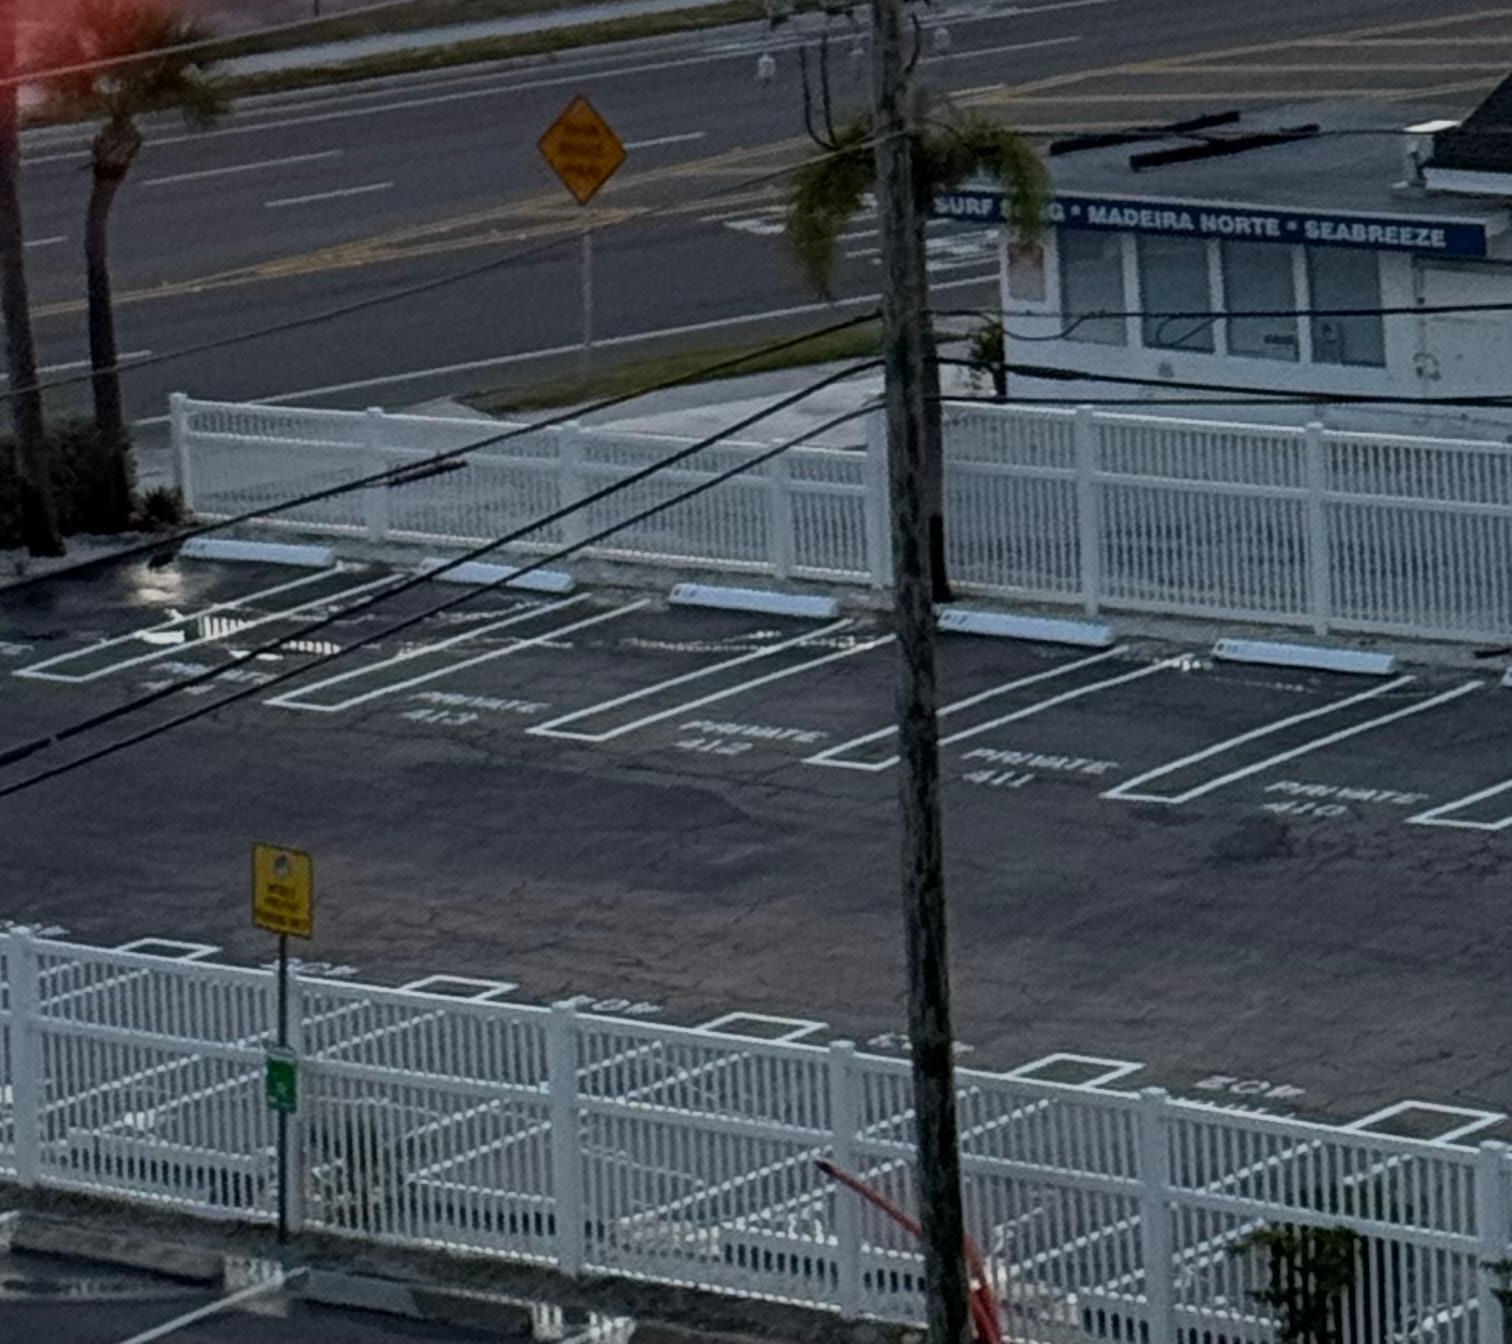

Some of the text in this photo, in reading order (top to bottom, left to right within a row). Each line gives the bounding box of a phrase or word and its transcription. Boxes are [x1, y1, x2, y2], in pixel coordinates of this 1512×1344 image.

[933, 195, 1447, 249] SURF SG MADEIRA NORTE SEABREEZE
[679, 720, 830, 744] PRIVATE
[960, 748, 1121, 775] PRIVATE
[962, 769, 1037, 788] 411
[1263, 780, 1430, 805] PRIVATE
[1261, 800, 1349, 817] 410
